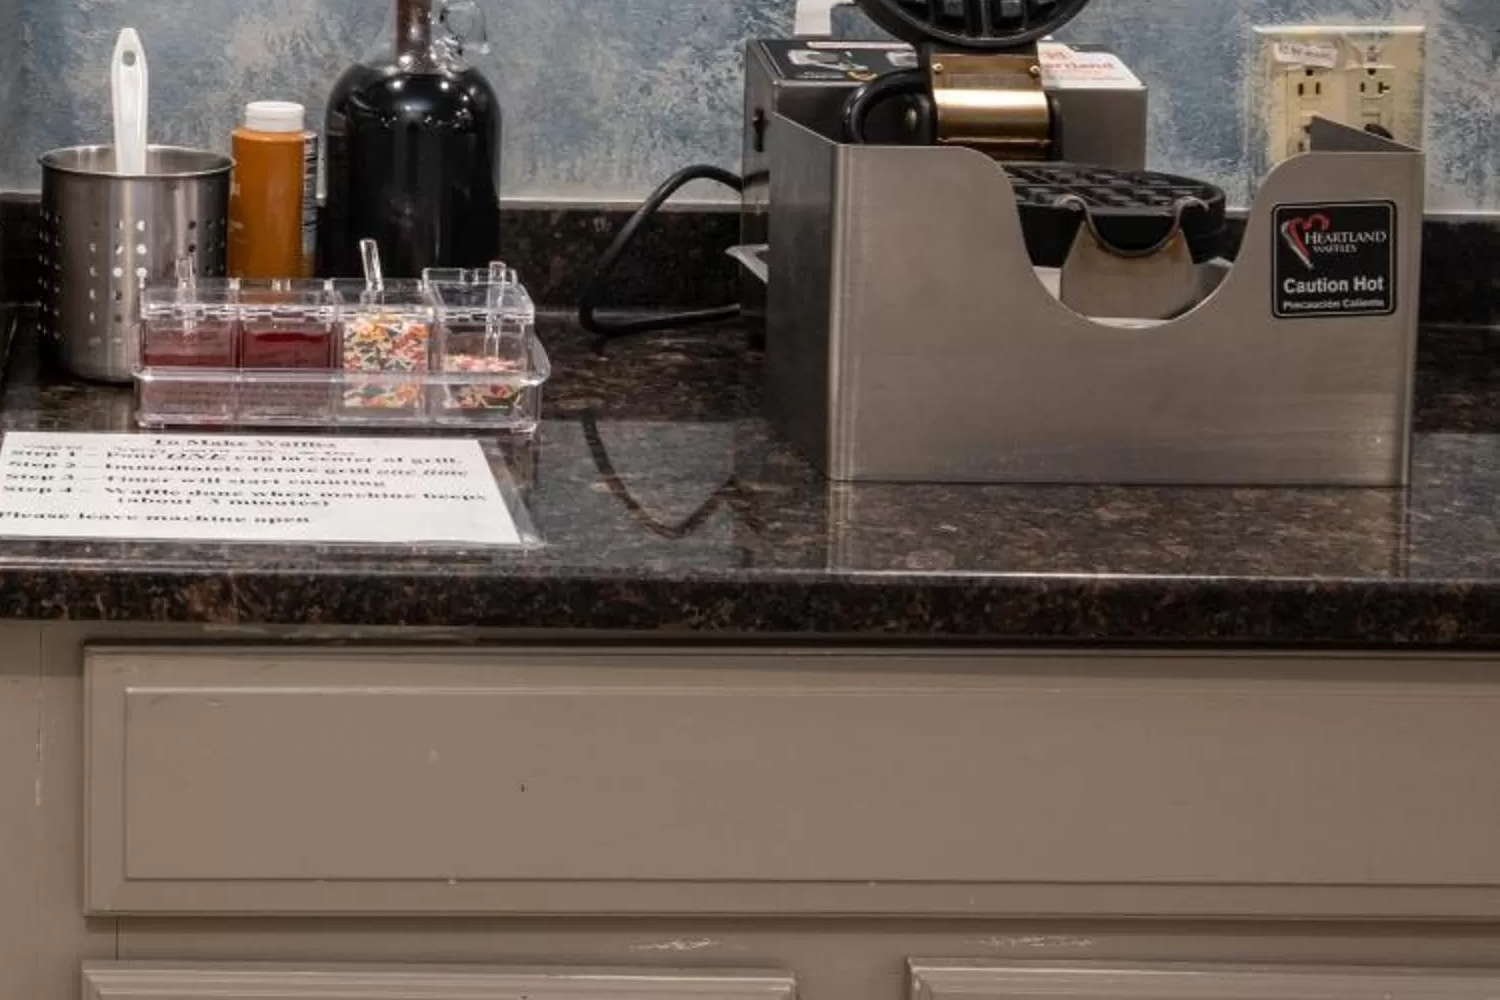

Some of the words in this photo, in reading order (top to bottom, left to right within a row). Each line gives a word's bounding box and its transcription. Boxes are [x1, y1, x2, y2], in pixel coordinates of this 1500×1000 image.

[1304, 231, 1387, 245] HEARTLAND
[1283, 276, 1349, 294] Caution
[1353, 275, 1385, 291] Hot
